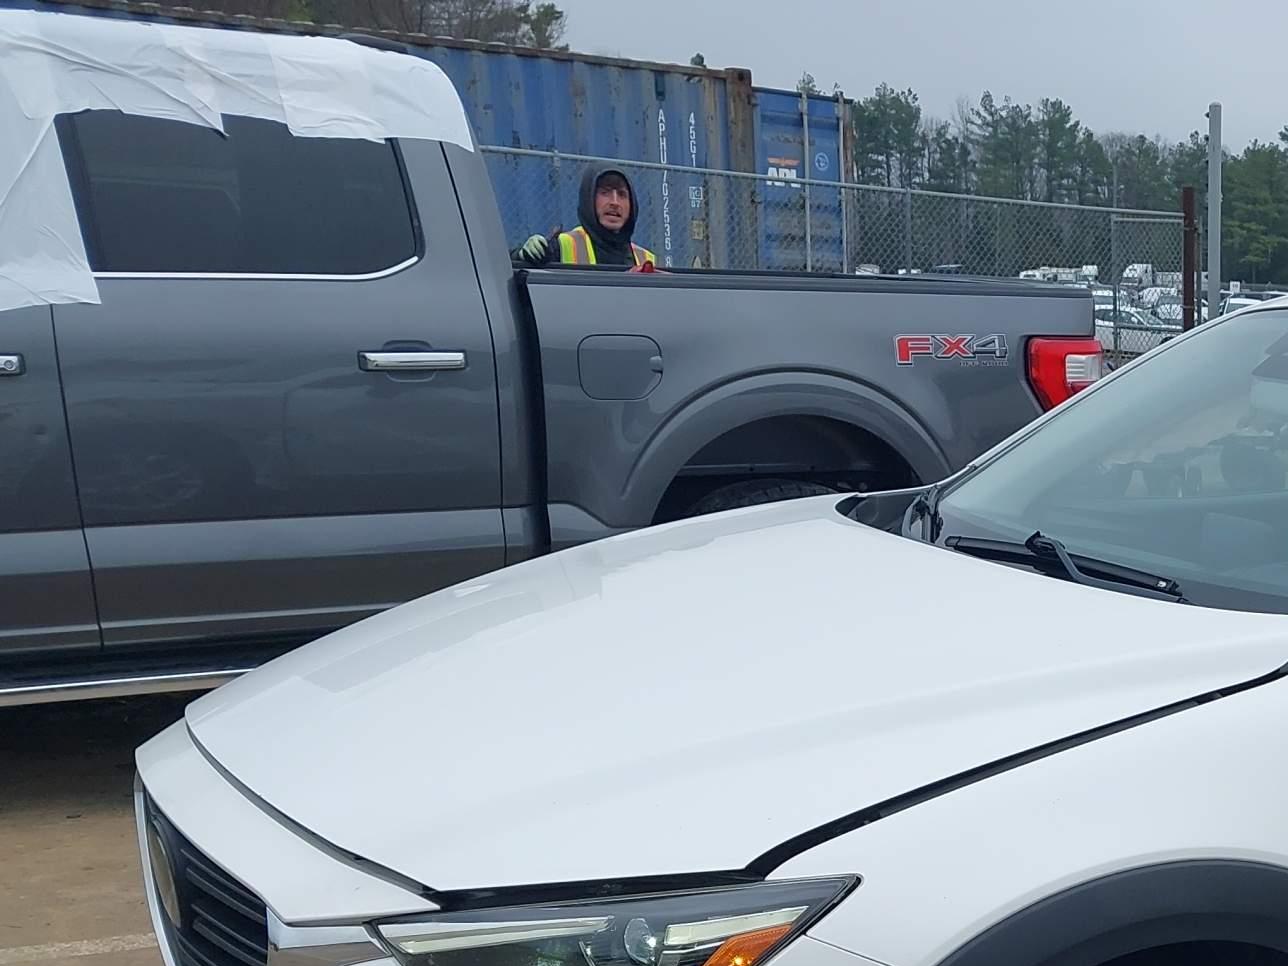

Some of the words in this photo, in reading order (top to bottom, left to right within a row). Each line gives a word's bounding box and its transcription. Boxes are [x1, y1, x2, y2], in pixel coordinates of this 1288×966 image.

[658, 109, 667, 164] APHU
[766, 167, 801, 188] APL
[895, 333, 1008, 368] FX4
